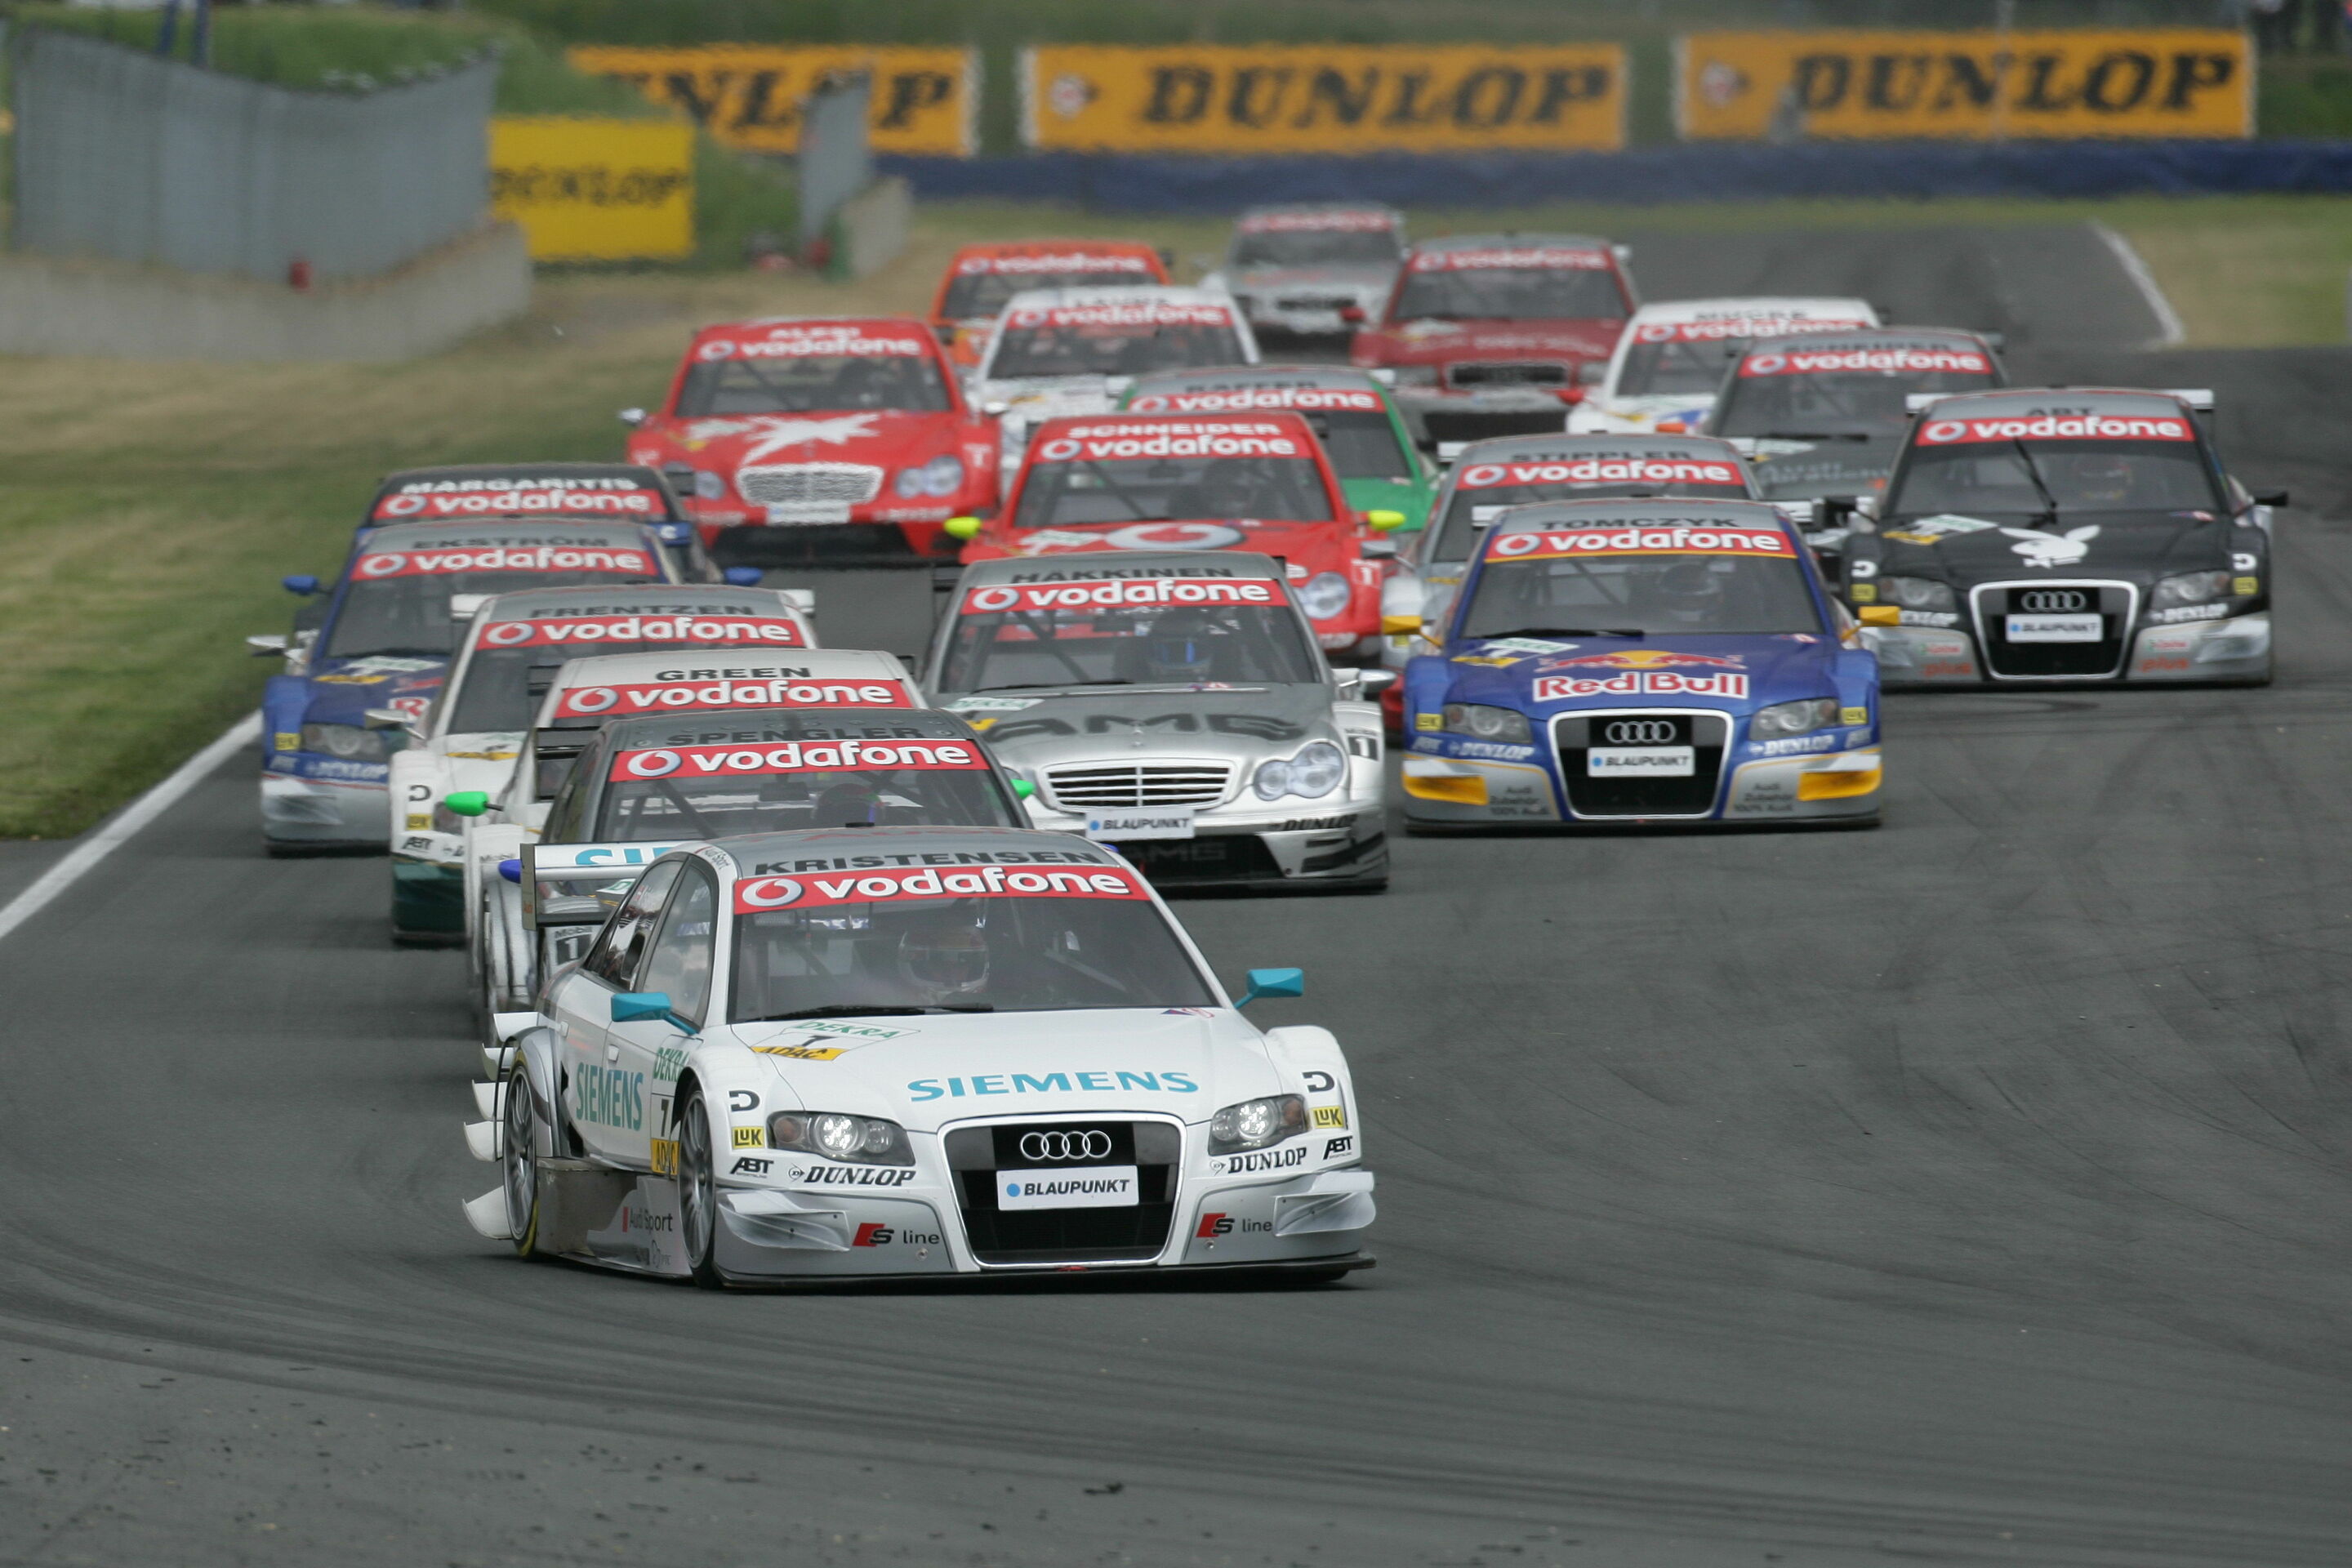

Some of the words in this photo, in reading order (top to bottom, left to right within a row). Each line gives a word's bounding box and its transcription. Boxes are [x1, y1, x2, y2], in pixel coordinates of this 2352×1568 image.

[1794, 51, 2234, 113] DUNLOP
[1142, 65, 1611, 129] DUNLOP
[1055, 304, 1225, 324] vodafone
[741, 336, 920, 356] vodafone
[1793, 350, 1984, 371] vodafone
[1175, 389, 1376, 410] vodafone
[1067, 422, 1281, 439] SCHNEIDER
[1973, 416, 2184, 439] vodafone
[1088, 434, 1296, 457] vodafone
[1512, 461, 1732, 482] vodafone
[401, 477, 639, 494] MARGARITIS
[433, 489, 650, 512] vodafone
[1541, 517, 1740, 531] TOMCZYK
[1548, 528, 1782, 551] vodafone
[413, 547, 644, 571] vodafone
[1027, 581, 1272, 606] vodafone
[531, 605, 755, 618] FRENTZEN
[542, 617, 792, 641] vodafone
[2021, 621, 2099, 635] BLAUPUNKT
[654, 667, 812, 681] GREEN
[1538, 672, 1636, 698] Red
[1647, 672, 1745, 697] Bull
[626, 680, 895, 707] vodafone
[666, 727, 929, 746] SPENGLER
[690, 742, 972, 771] vodafone
[1605, 755, 1690, 769] BLAUPUNKT
[1102, 817, 1191, 830] BLAUPUNKT
[755, 851, 1104, 875] KRISTENSEN
[813, 866, 1131, 900] vodafone
[564, 938, 578, 960] 1
[795, 1022, 900, 1039] DEKRA
[760, 1047, 828, 1059] ADAC
[653, 1046, 690, 1083] DEKRA
[576, 1062, 644, 1132] SIEMENS
[907, 1071, 1199, 1102] SIEMENS
[1322, 1135, 1353, 1160] ABT
[730, 1156, 774, 1175] ABT
[1227, 1147, 1307, 1174] DUNLOP
[804, 1165, 917, 1187] DUNLOP
[1023, 1178, 1131, 1196] BLAUPUNKT
[1241, 1217, 1273, 1232] line
[902, 1229, 940, 1245] line
